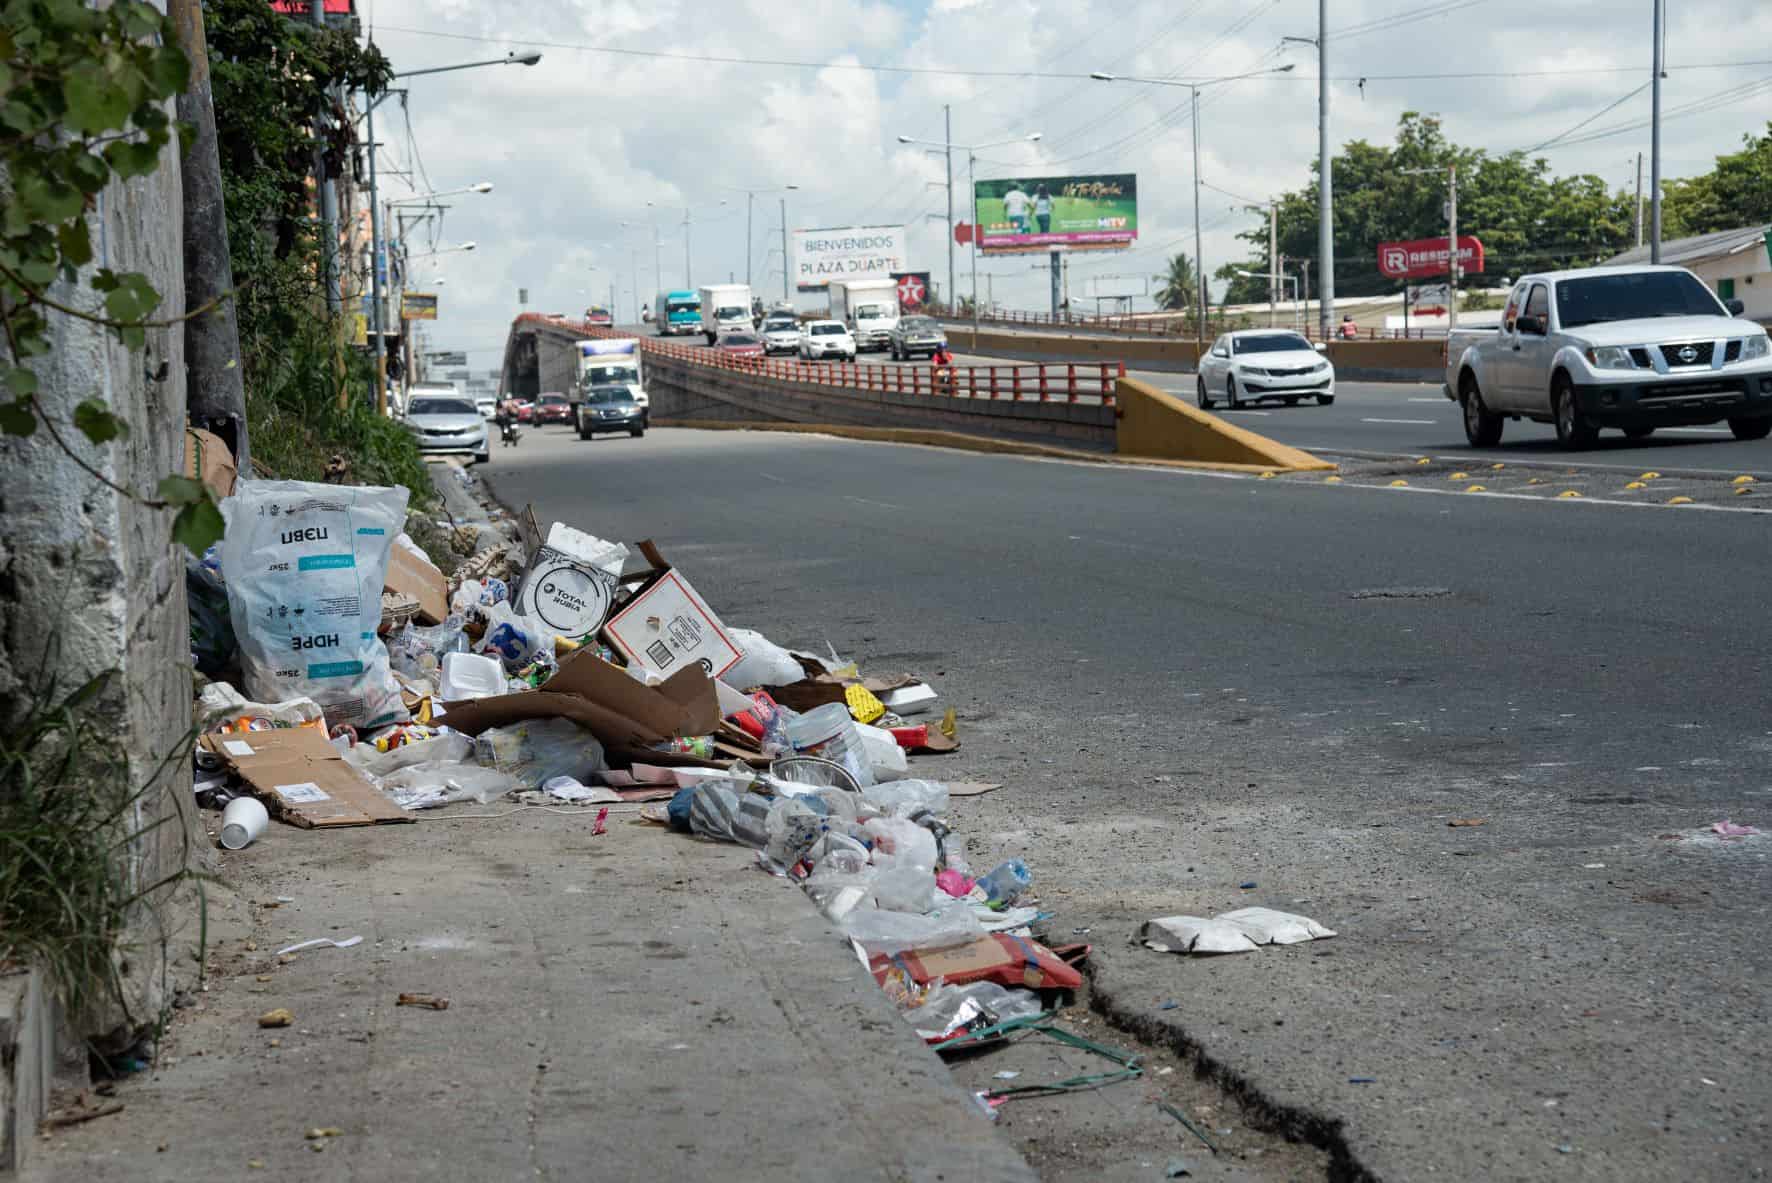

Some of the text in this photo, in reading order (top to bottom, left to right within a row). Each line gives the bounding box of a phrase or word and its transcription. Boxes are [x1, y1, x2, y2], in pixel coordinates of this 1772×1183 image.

[805, 235, 893, 252] BIENVENIDOS
[799, 259, 844, 275] PLAZA
[848, 255, 903, 272] DUARTE
[1387, 252, 1408, 272] R
[281, 527, 328, 544] ПЭВП
[552, 597, 581, 612] RUBIA
[557, 589, 587, 608] TOTAL
[291, 633, 339, 650] HDPE
